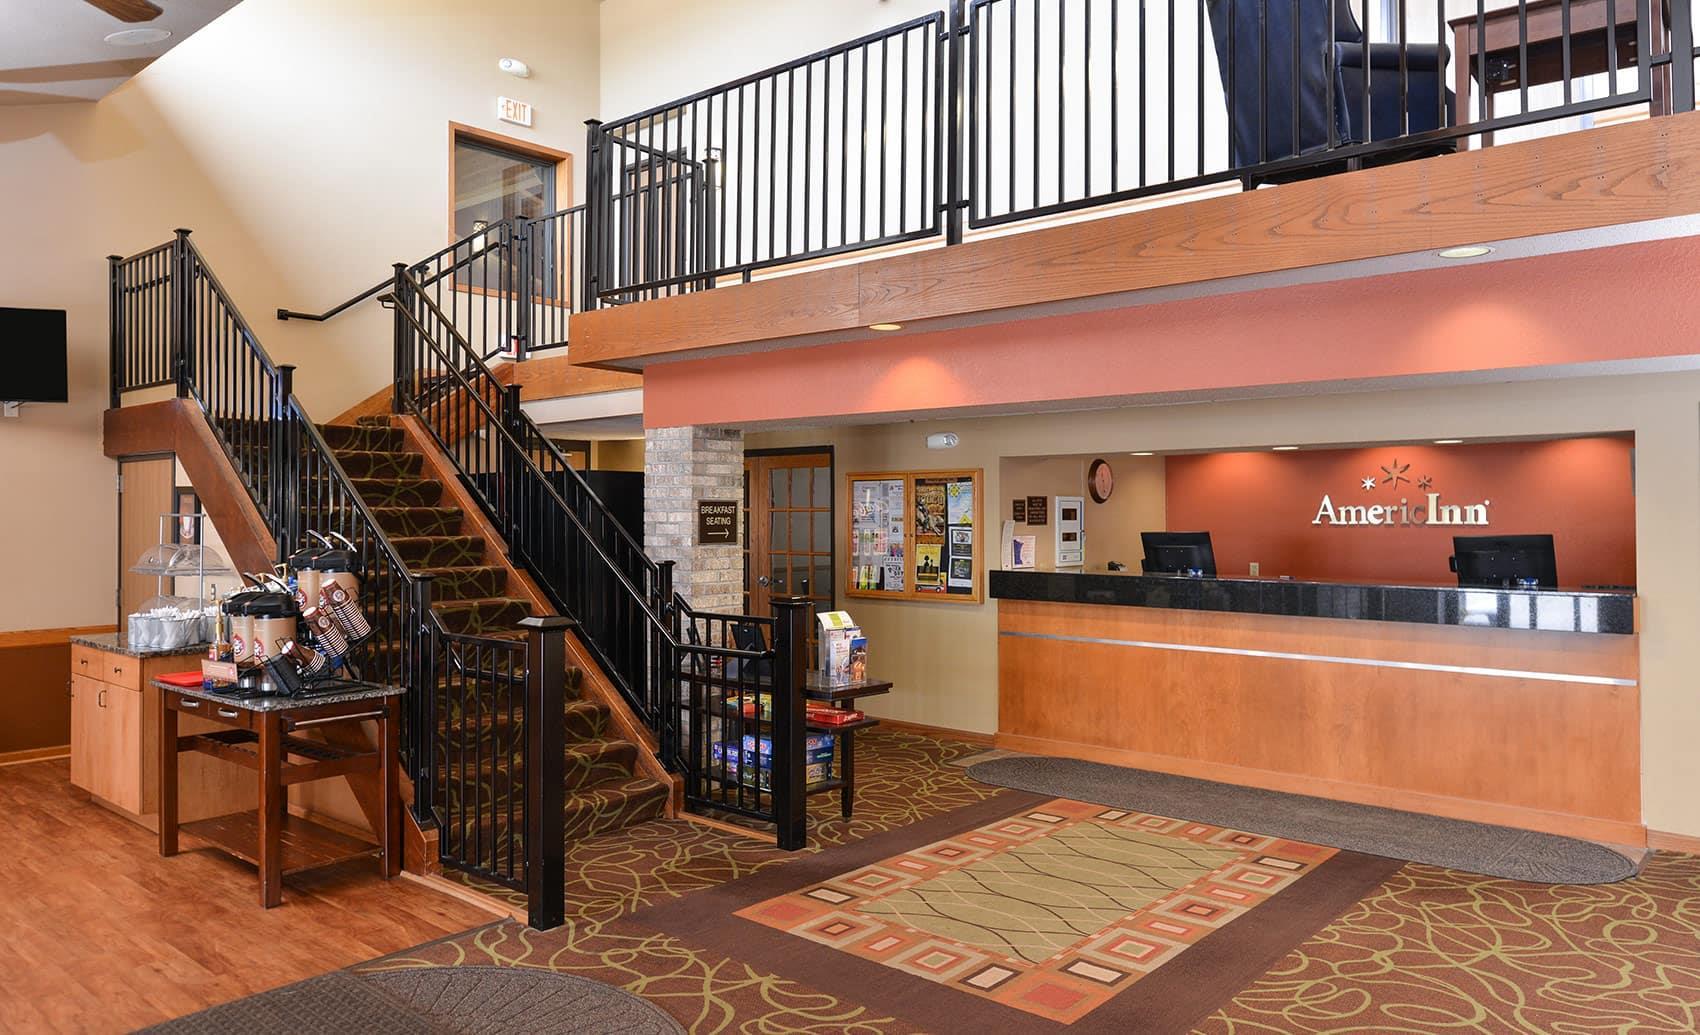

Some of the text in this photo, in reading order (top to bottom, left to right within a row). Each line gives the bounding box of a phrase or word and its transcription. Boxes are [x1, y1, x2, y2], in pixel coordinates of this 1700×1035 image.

[505, 99, 527, 123] EXIT
[701, 505, 736, 514] BREAKFAST
[1312, 493, 1489, 525] AmericInn
[706, 517, 731, 526] SEATING
